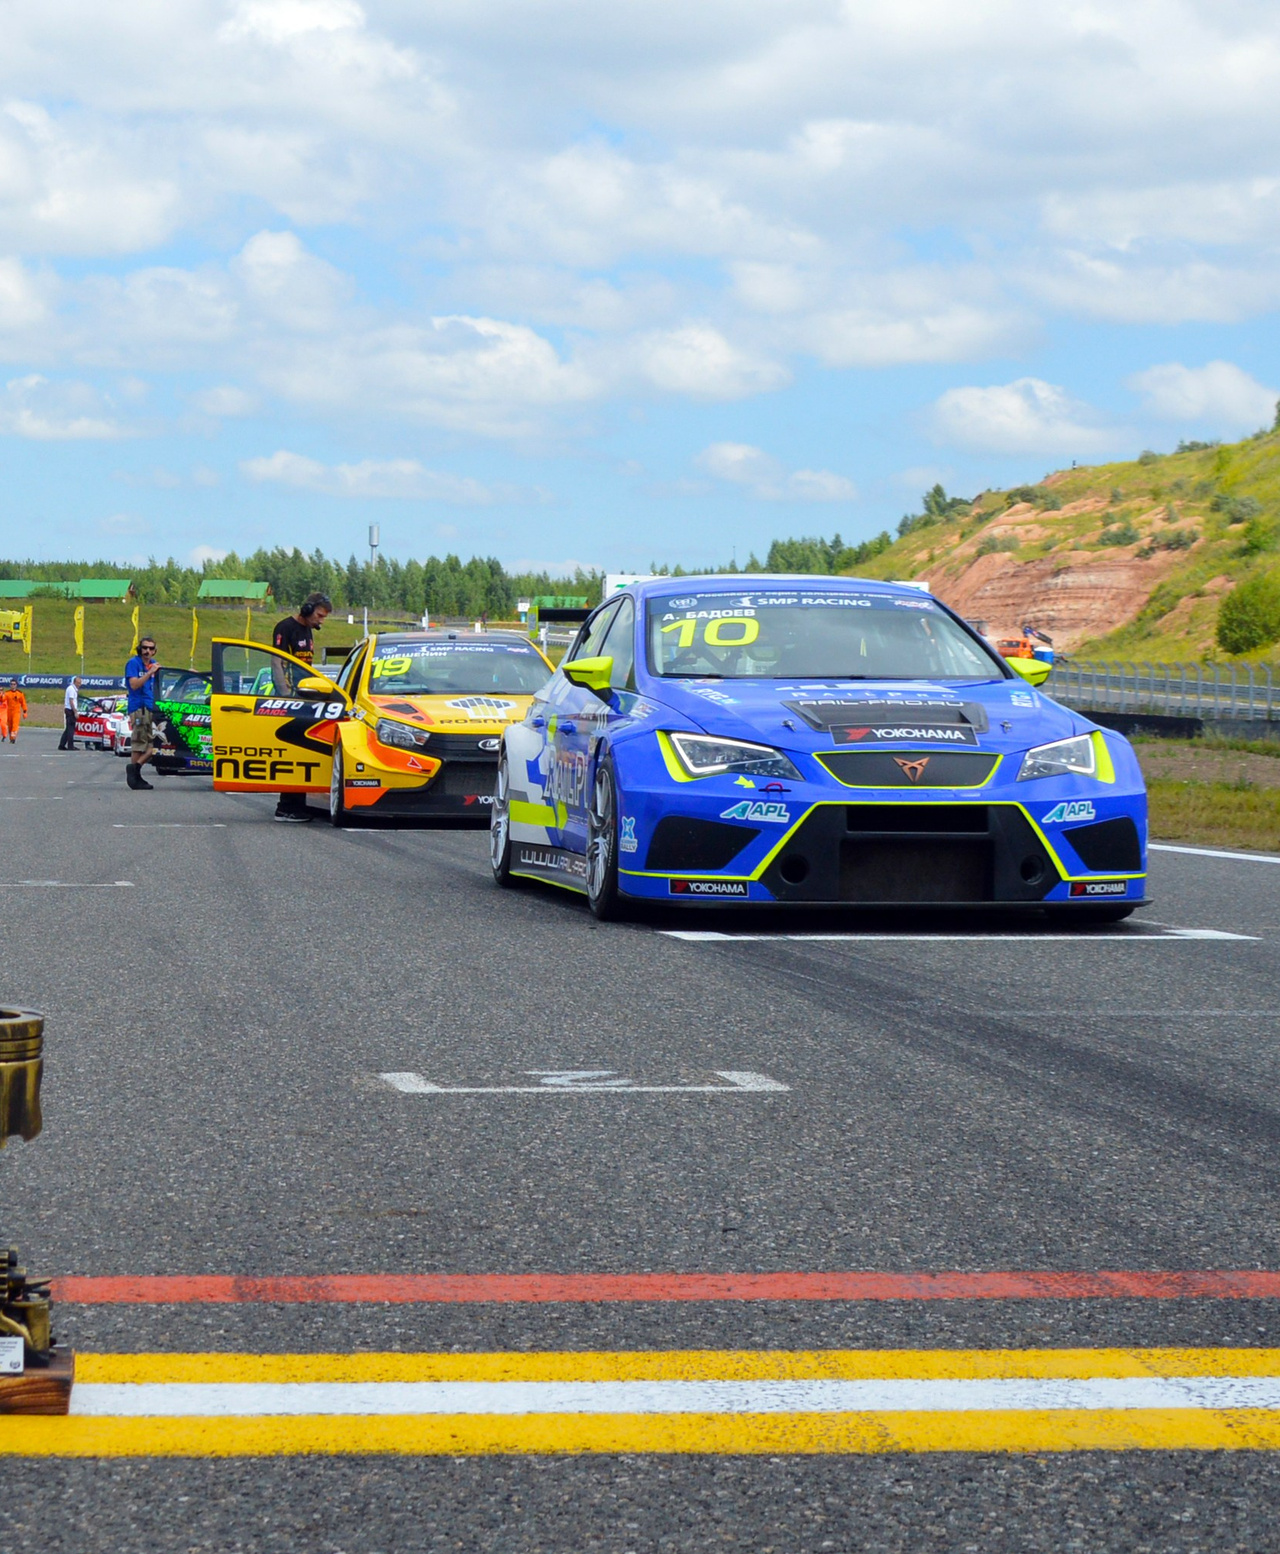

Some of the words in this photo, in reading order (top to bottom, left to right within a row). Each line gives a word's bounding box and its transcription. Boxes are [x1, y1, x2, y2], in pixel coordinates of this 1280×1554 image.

[757, 597, 799, 606] SMP
[801, 597, 872, 608] RACING
[662, 611, 680, 621] А.
[685, 608, 756, 620] БАДОЕВ
[659, 617, 760, 648] 10
[382, 650, 448, 661] ШЕШЕНИН
[371, 657, 413, 679] 19
[41, 677, 63, 685] RACING
[259, 699, 305, 710] АВТО
[311, 701, 344, 719] 19
[871, 727, 966, 741] YOKOHAMA
[214, 745, 288, 759] SPORT
[215, 758, 321, 783] NEFT
[688, 881, 745, 895] YOKOHAMA
[1085, 883, 1126, 894] YOKOHAMA
